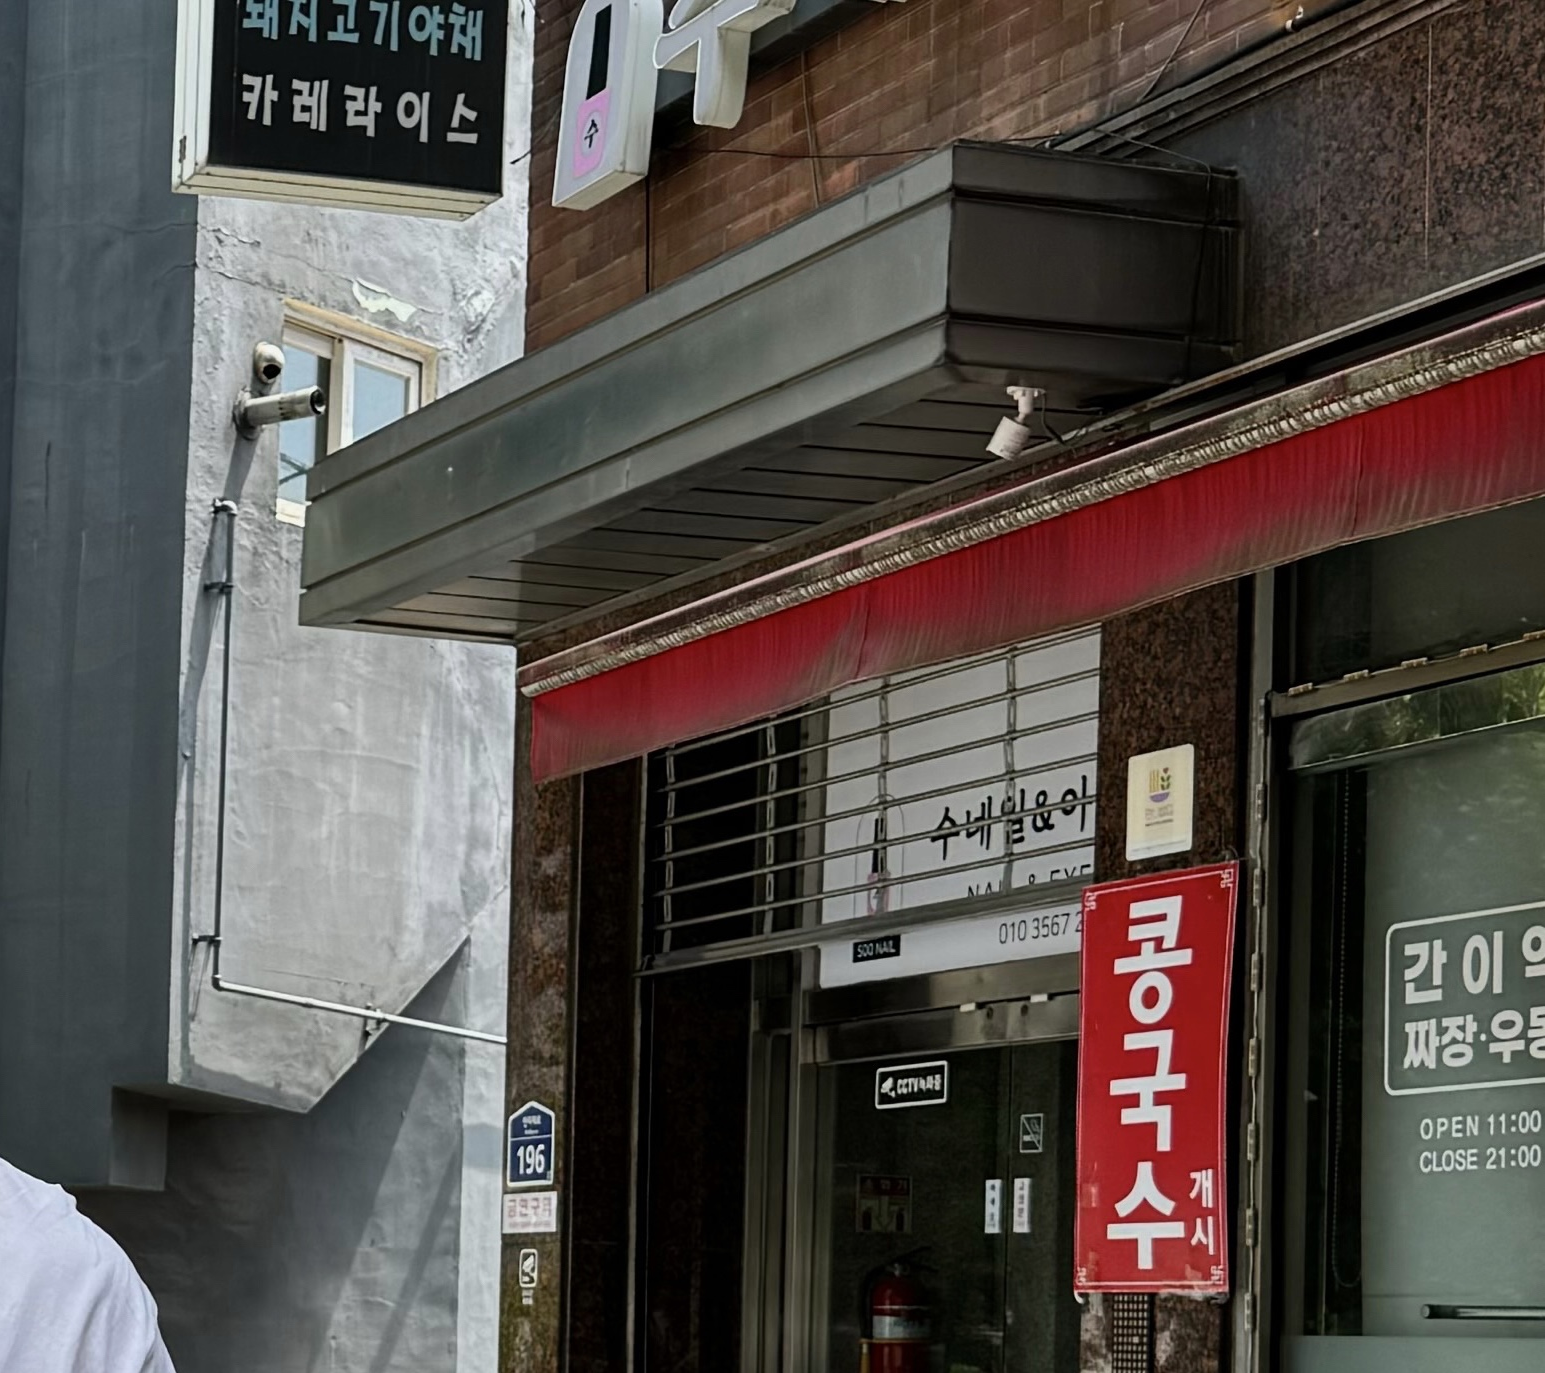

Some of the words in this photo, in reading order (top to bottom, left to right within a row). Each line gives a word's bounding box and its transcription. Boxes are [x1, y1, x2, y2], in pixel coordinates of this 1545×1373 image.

[242, 73, 479, 145] 카레라이스
[998, 919, 1027, 945] 010
[1032, 912, 1070, 940] 3567
[1106, 894, 1194, 1270] 콩국수
[1419, 1115, 1480, 1140] OPEN
[1486, 1109, 1542, 1136] 11:00
[516, 1143, 546, 1175] 196
[1419, 1148, 1479, 1173] CLOSE
[1485, 1143, 1542, 1171] 21:00
[1188, 1168, 1217, 1256] 개시
